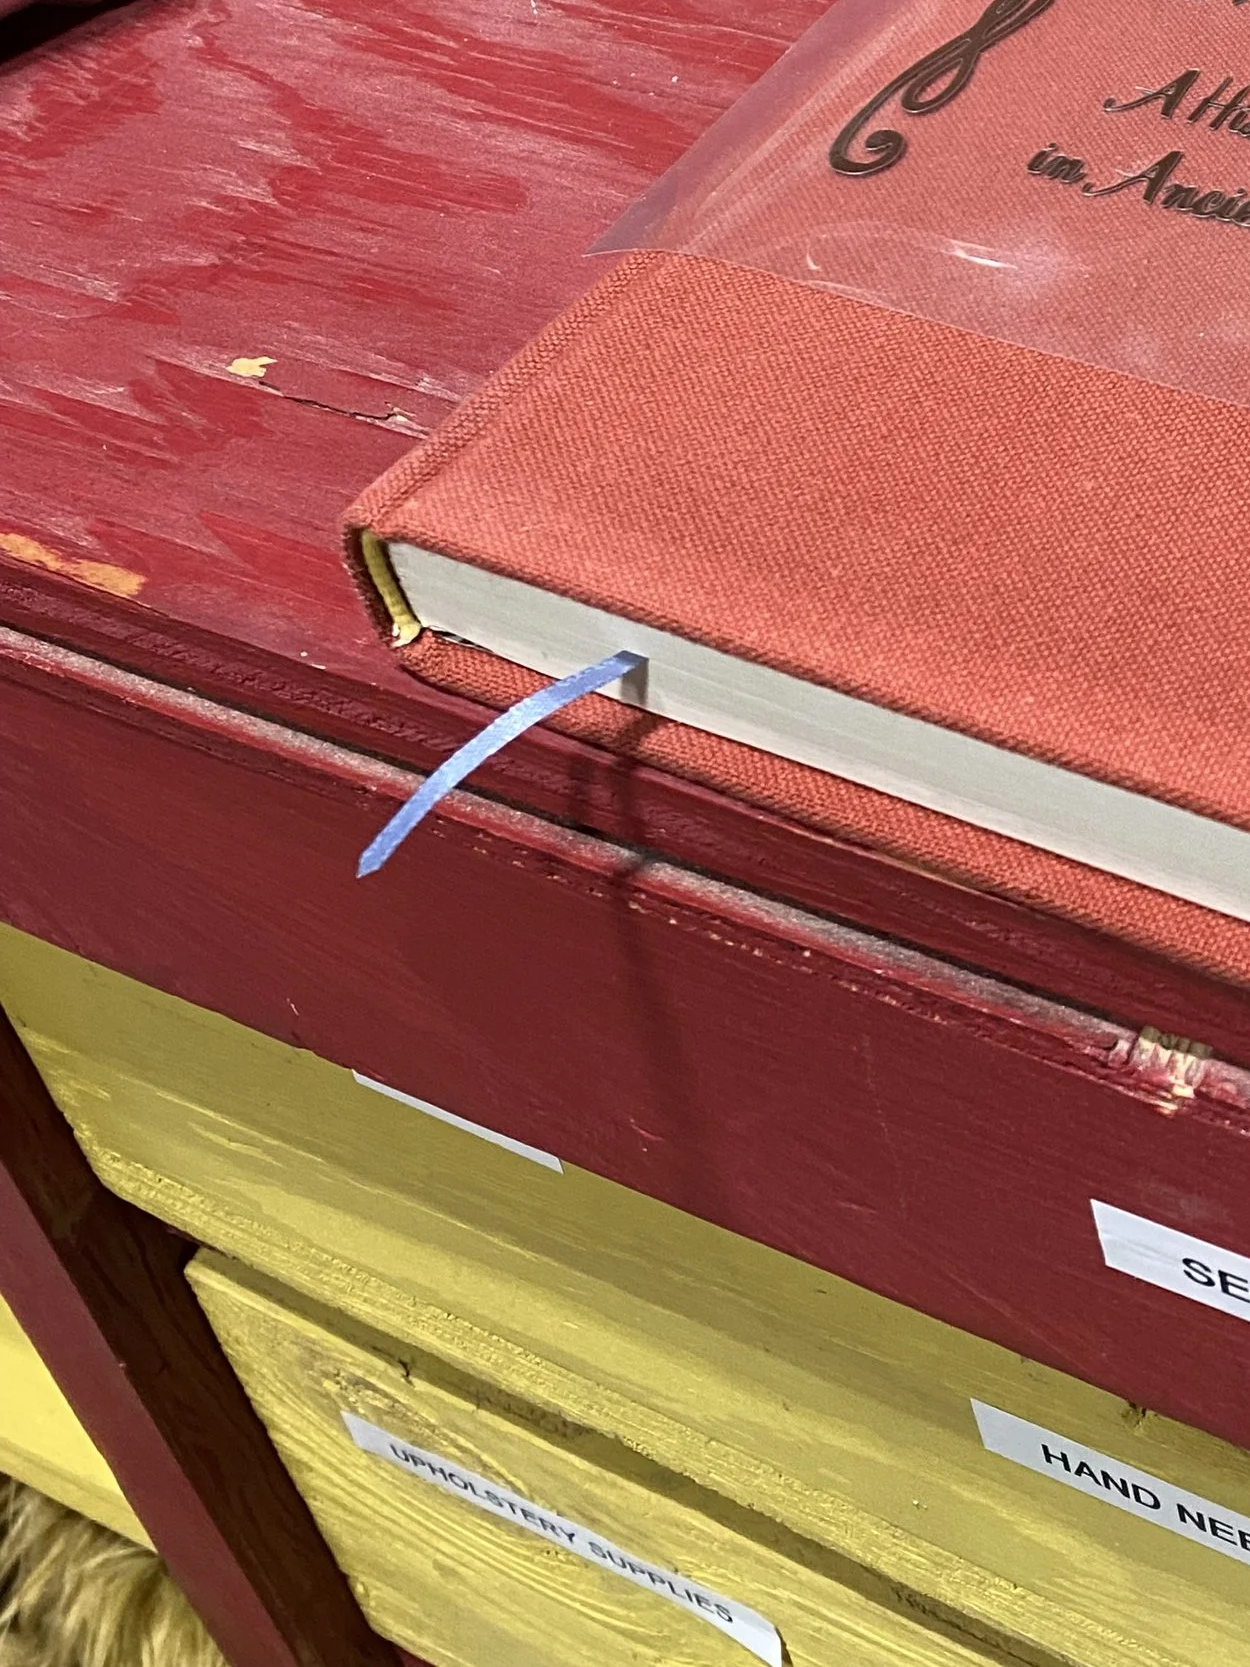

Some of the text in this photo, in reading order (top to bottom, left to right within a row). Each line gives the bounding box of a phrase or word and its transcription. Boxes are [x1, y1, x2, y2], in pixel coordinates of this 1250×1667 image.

[1102, 68, 1201, 119] A
[1026, 142, 1086, 184] in
[1040, 1443, 1161, 1511] HAND
[389, 1443, 734, 1624] UPHOLSTERY SUPPLIES
